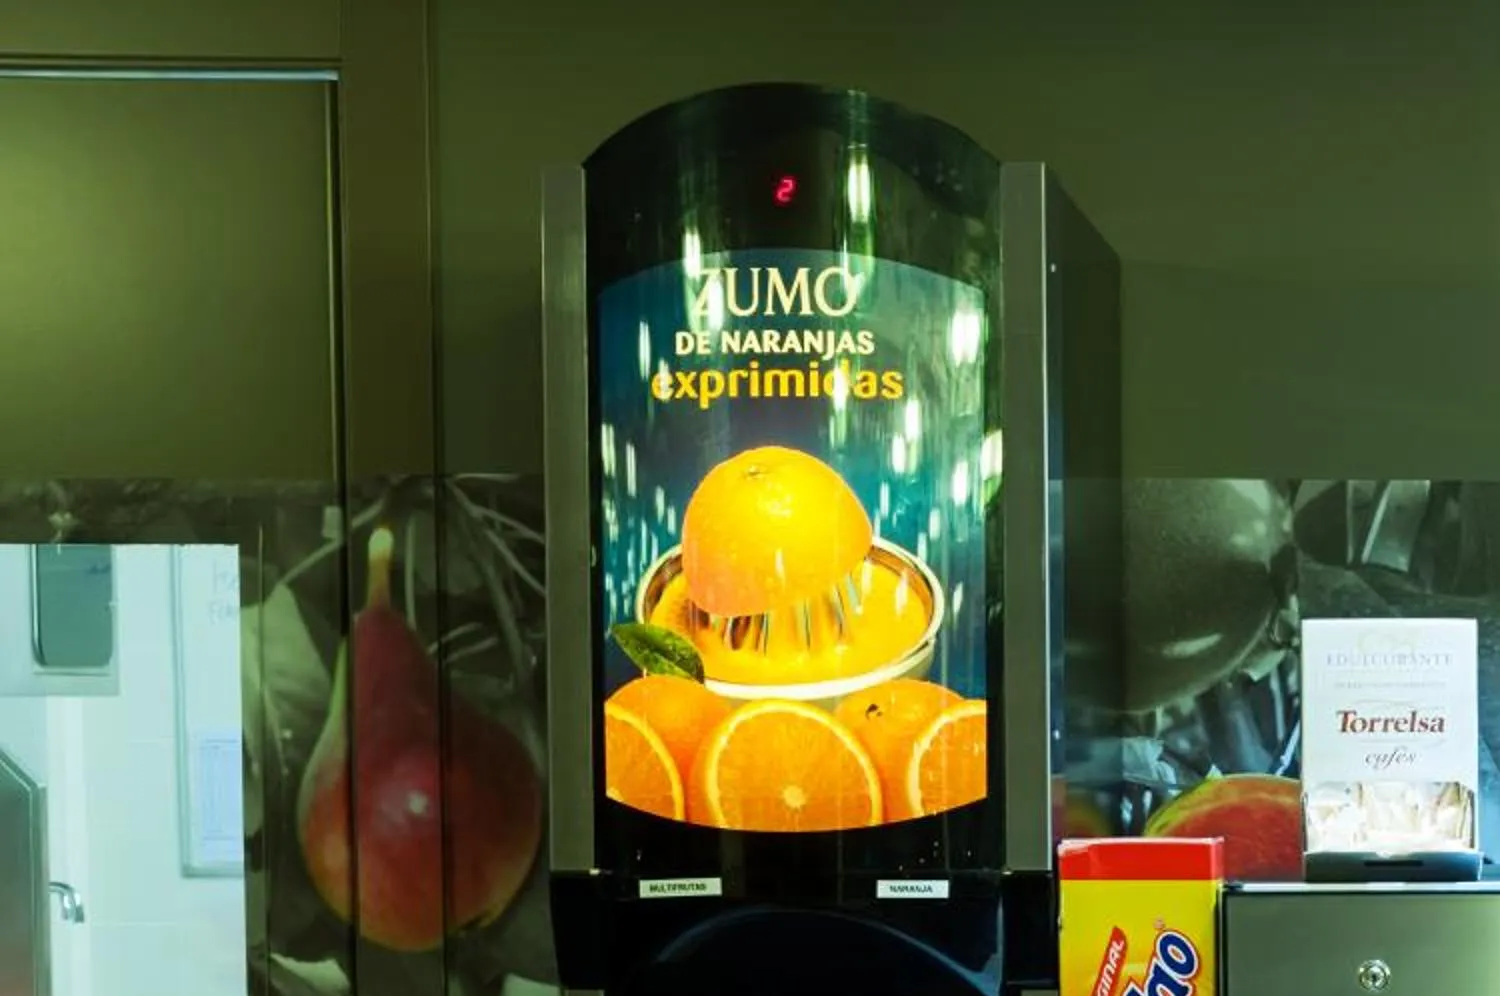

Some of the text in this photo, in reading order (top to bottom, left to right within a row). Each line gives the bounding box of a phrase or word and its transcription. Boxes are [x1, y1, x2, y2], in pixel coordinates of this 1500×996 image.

[692, 266, 860, 317] ZUMO
[675, 331, 875, 360] DE NARANJAS
[651, 359, 904, 409] exprimidas
[1336, 709, 1445, 733] Torrelsa
